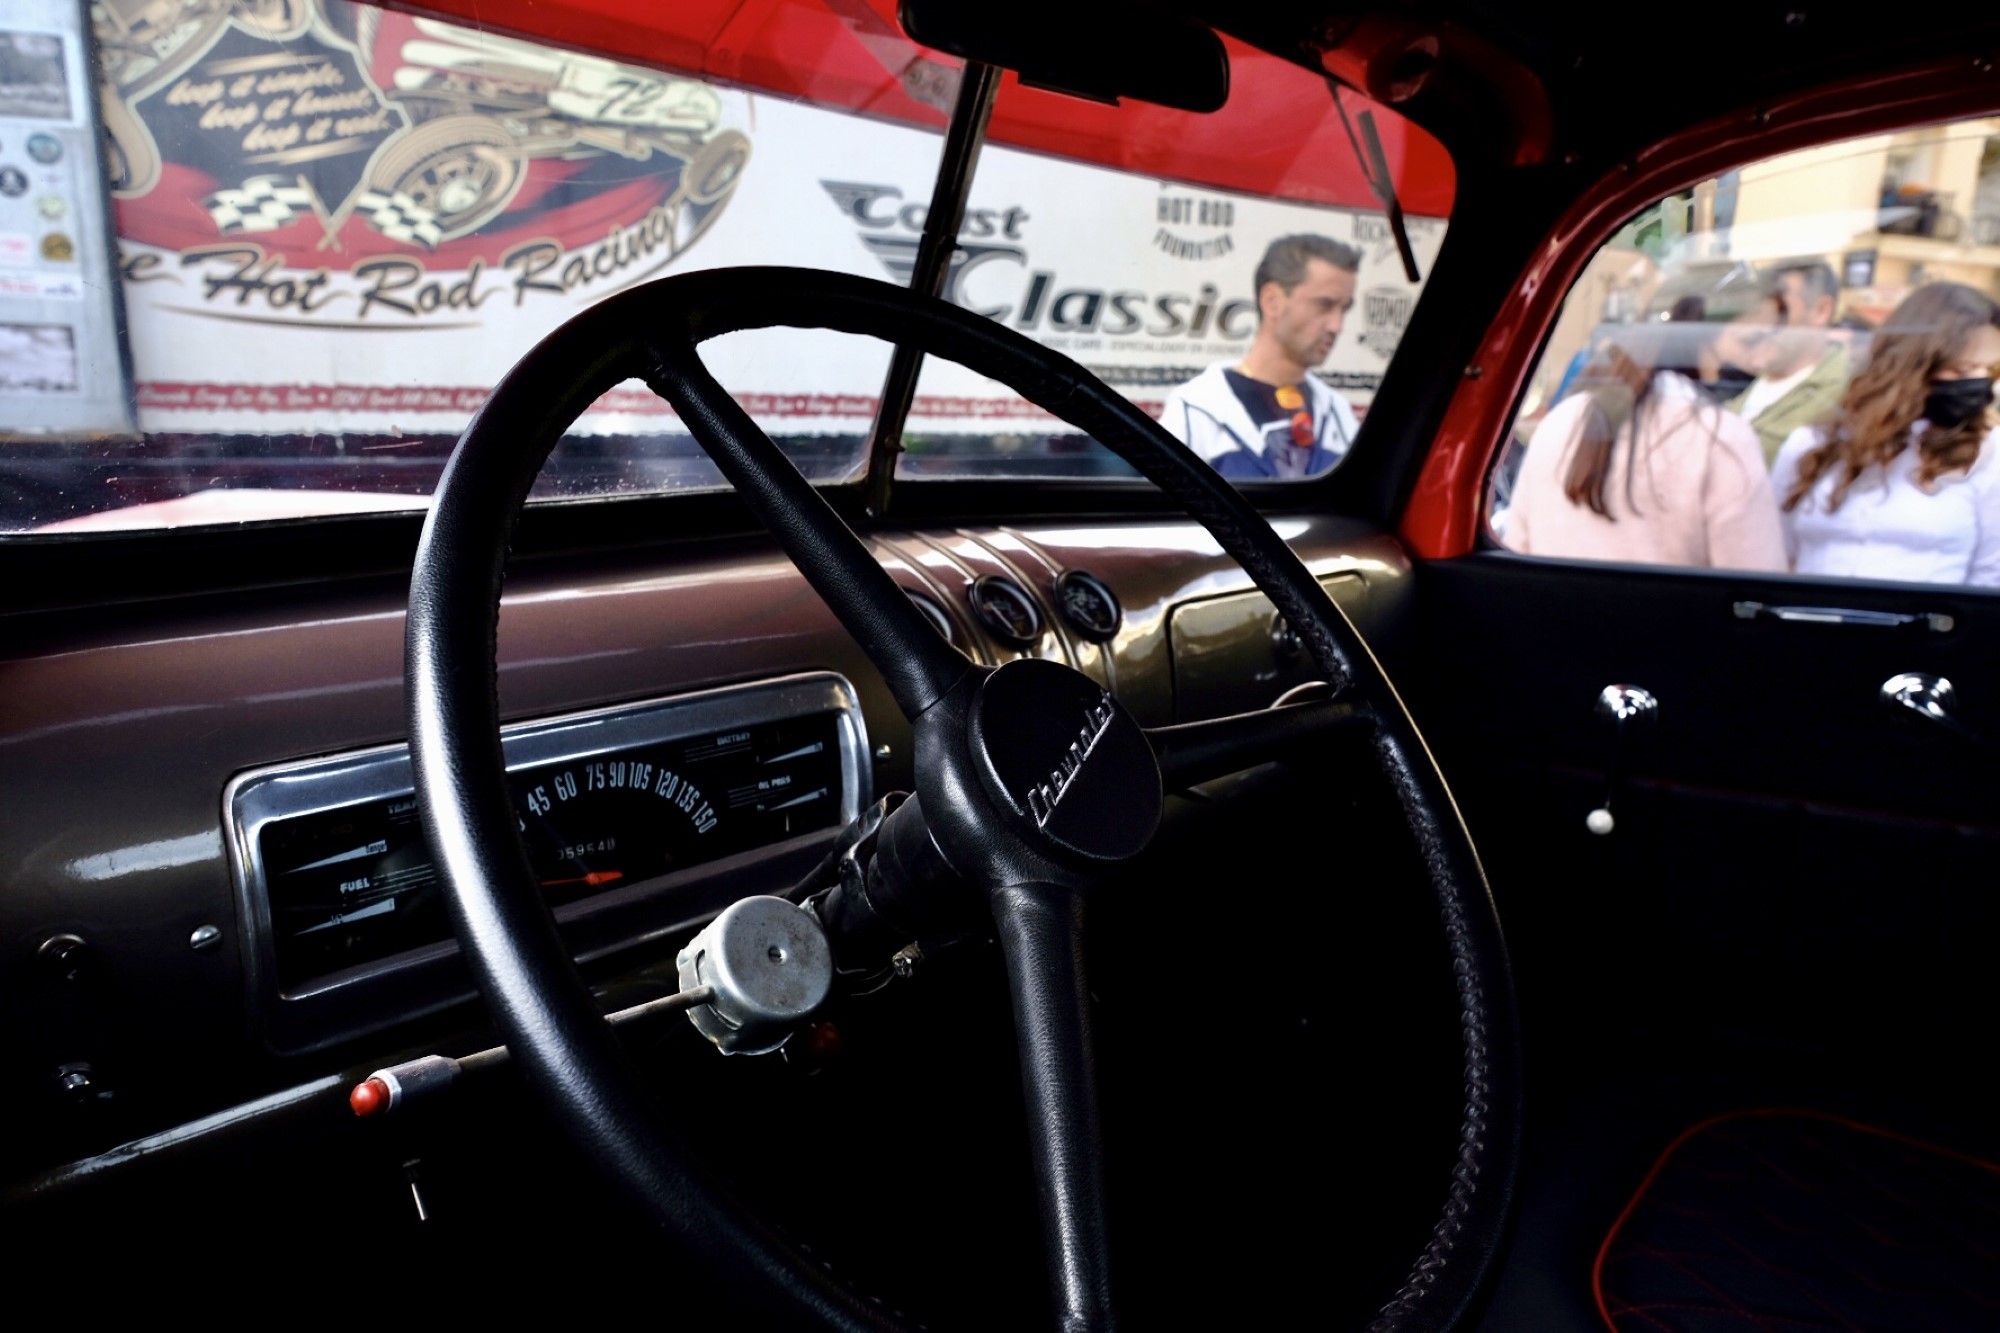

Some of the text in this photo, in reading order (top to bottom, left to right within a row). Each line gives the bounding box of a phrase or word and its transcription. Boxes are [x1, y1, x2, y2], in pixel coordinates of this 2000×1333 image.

[598, 76, 671, 120] 72
[850, 186, 1030, 241] Cost
[1157, 197, 1234, 227] HOT ROD
[181, 243, 340, 313] Hot
[353, 256, 490, 318] Rod
[503, 203, 682, 306] Racing
[527, 760, 721, 835] 45 60 75 90 105 120 135 150
[340, 877, 370, 895] FUEL
